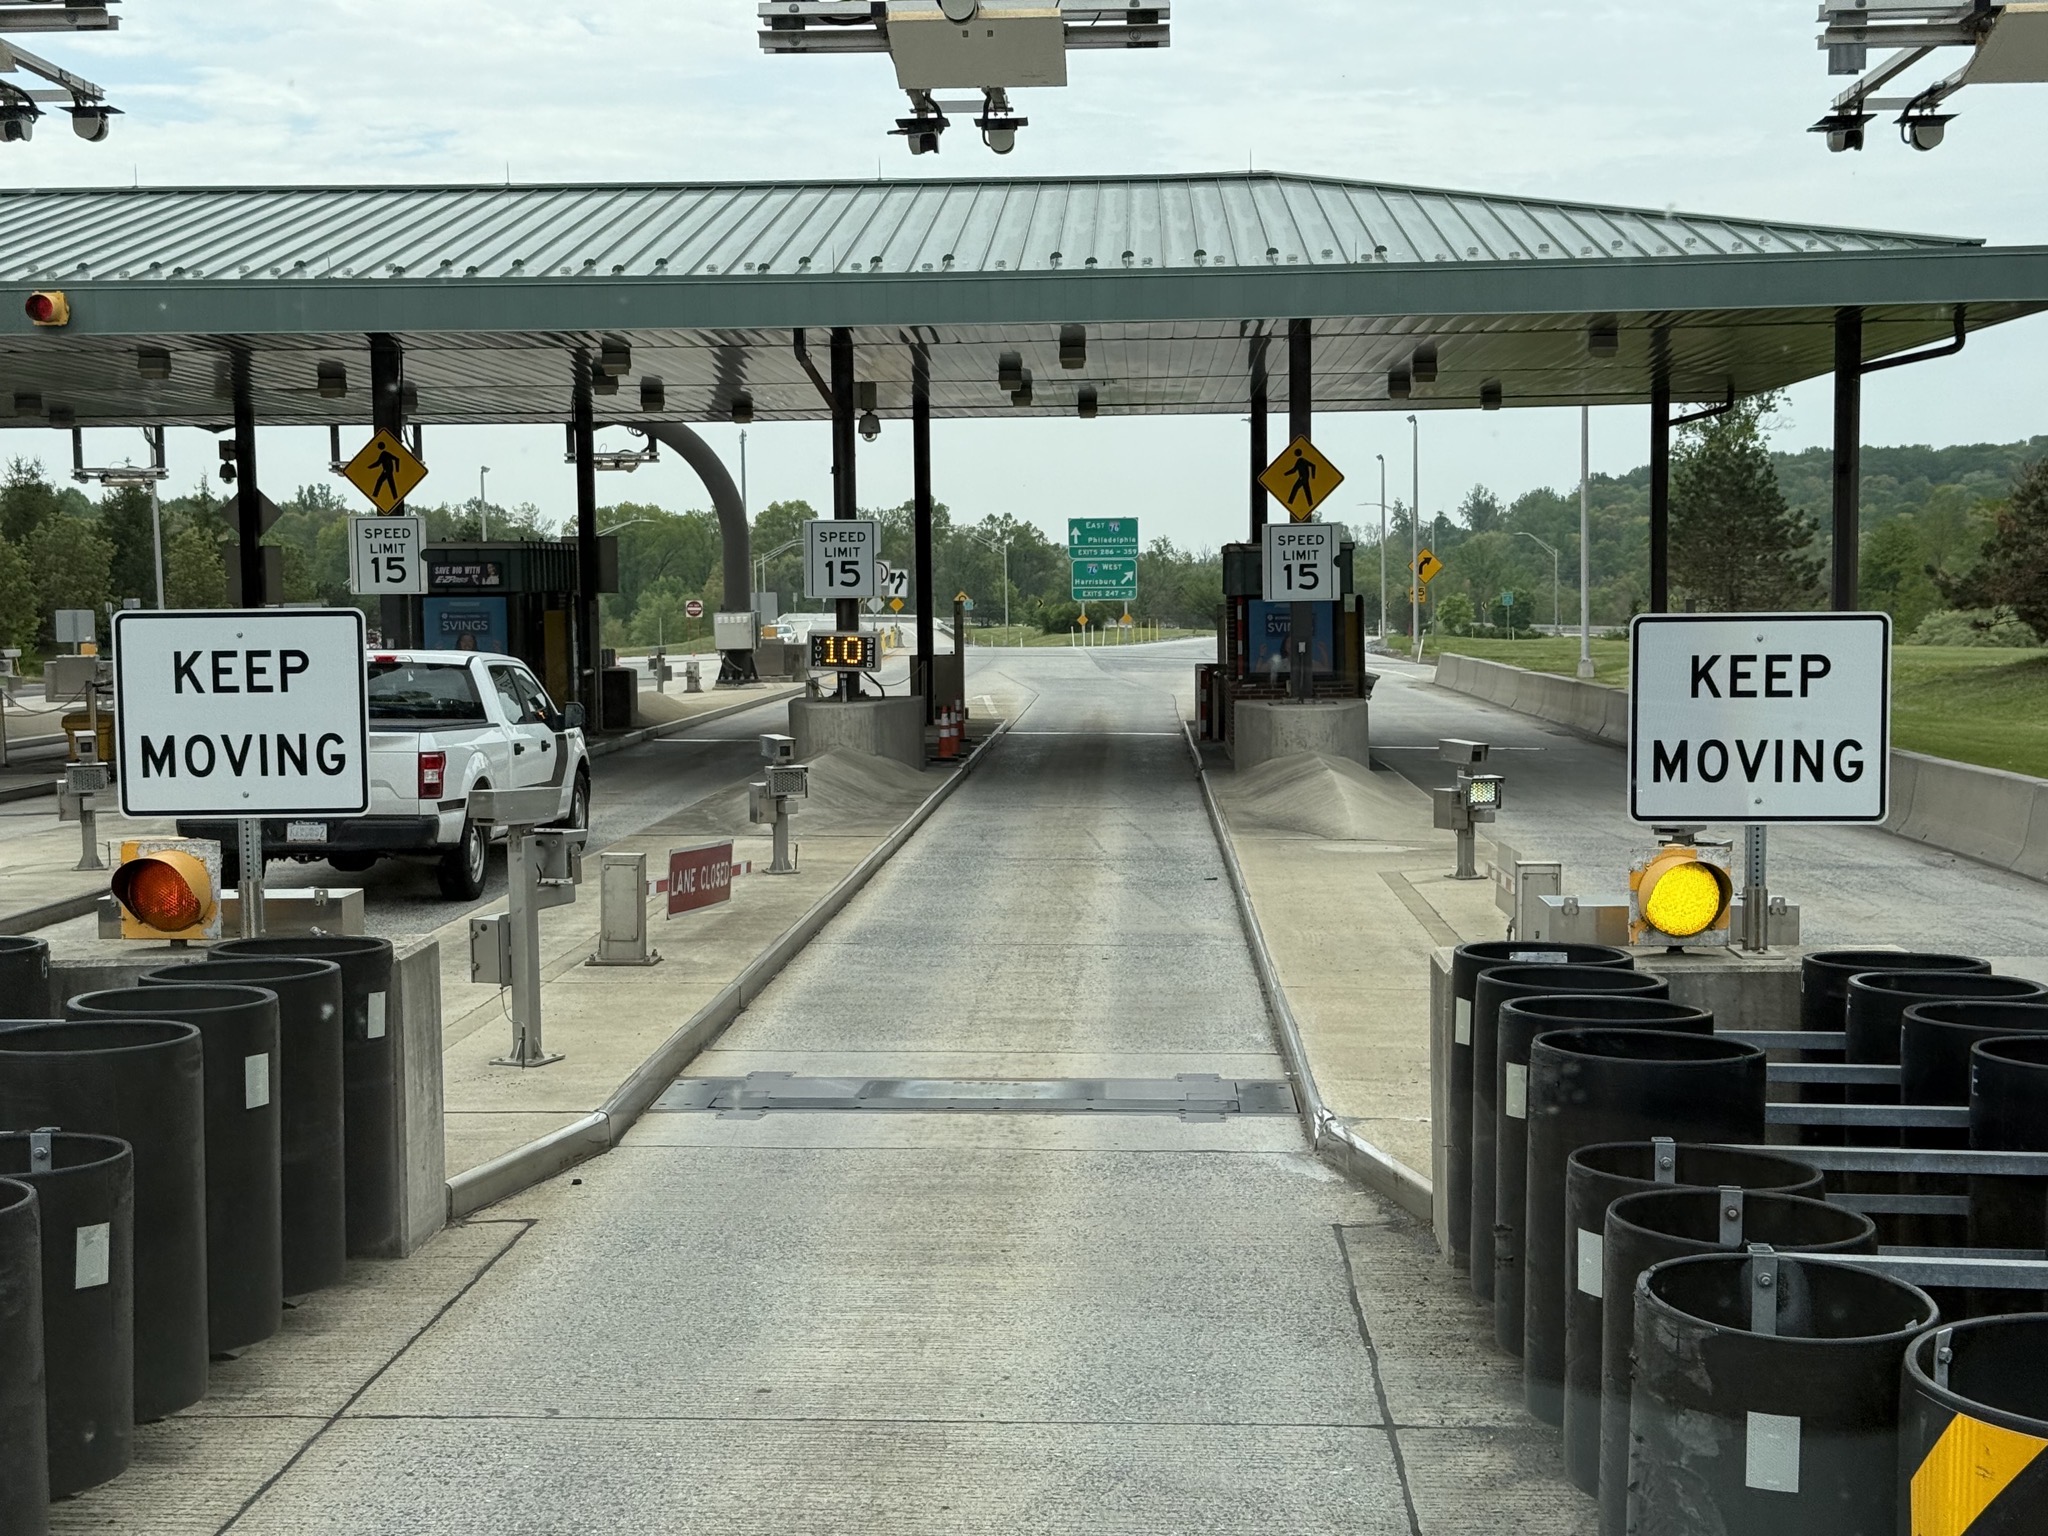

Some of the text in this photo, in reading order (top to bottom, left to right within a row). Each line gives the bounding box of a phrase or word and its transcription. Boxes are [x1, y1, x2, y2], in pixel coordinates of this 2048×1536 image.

[364, 528, 411, 539] SPEED
[819, 531, 866, 542] SPEED
[1110, 523, 1119, 532] 76
[1278, 535, 1325, 546] SPEED
[370, 543, 406, 554] LIMIT
[824, 547, 861, 558] LIMIT
[1282, 550, 1319, 561] LIMIT
[371, 556, 407, 583] 15
[434, 566, 450, 575] SAVE
[464, 565, 481, 575] WITH
[825, 561, 861, 587] 15
[1283, 563, 1319, 590] 15
[442, 620, 488, 631] SVINGS
[826, 636, 862, 664] 10
[866, 637, 874, 668] SPEED
[173, 649, 310, 694] KEEP
[1690, 653, 1832, 698] KEEP
[140, 732, 346, 778] MOVING
[1652, 738, 1864, 783] MOVING
[671, 861, 730, 897] LANE CLOSED
